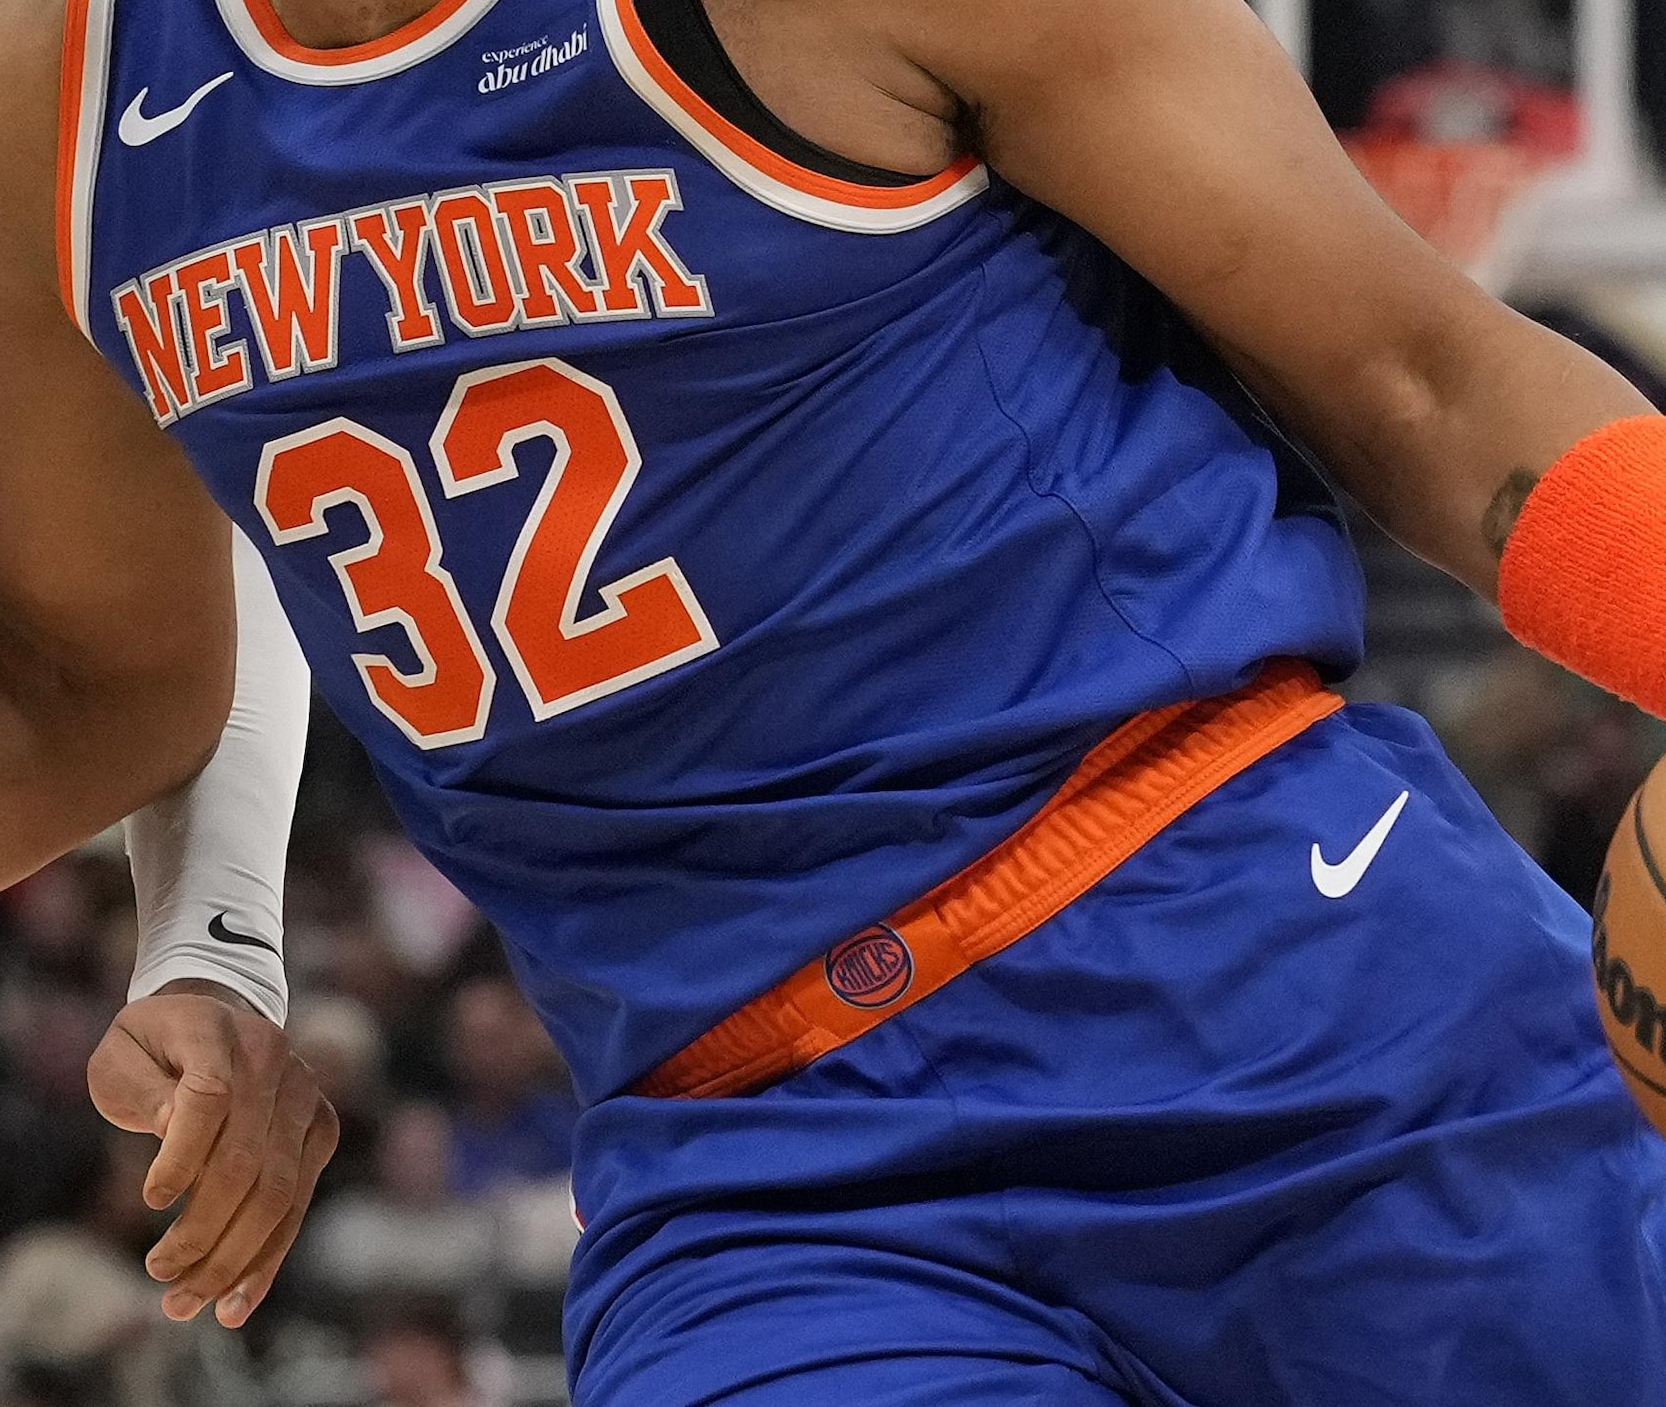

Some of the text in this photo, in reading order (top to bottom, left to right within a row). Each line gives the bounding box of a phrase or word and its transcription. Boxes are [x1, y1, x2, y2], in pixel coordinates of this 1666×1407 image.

[478, 22, 588, 94] abu dhabi
[481, 35, 549, 64] experience
[111, 169, 715, 428] NEW YORK
[254, 358, 720, 750] 32
[834, 940, 902, 992] KNICKS
